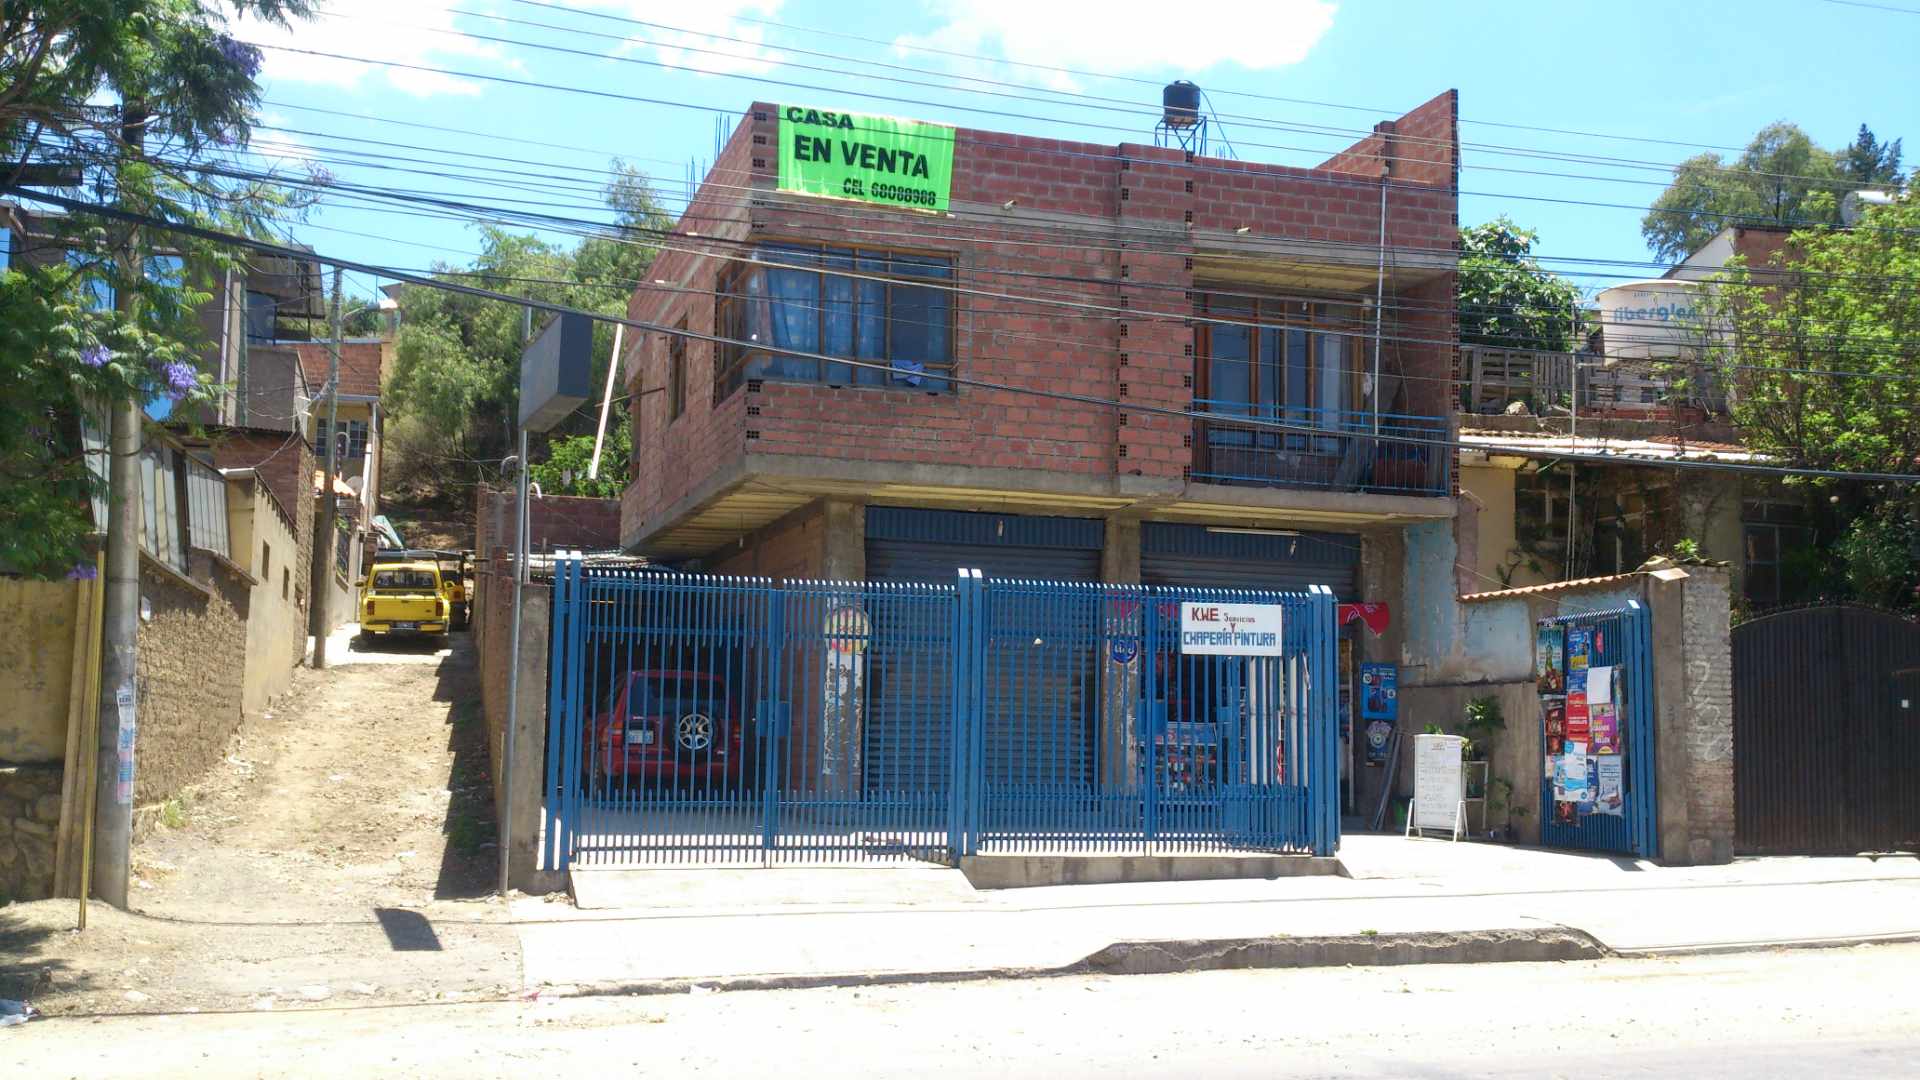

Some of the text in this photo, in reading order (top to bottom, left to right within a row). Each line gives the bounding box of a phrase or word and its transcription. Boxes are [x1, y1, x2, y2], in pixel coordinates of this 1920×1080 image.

[787, 106, 855, 130] CASA
[794, 134, 929, 179] EN VENTA
[843, 177, 865, 196] CEL
[1230, 622, 1237, 634] Y
